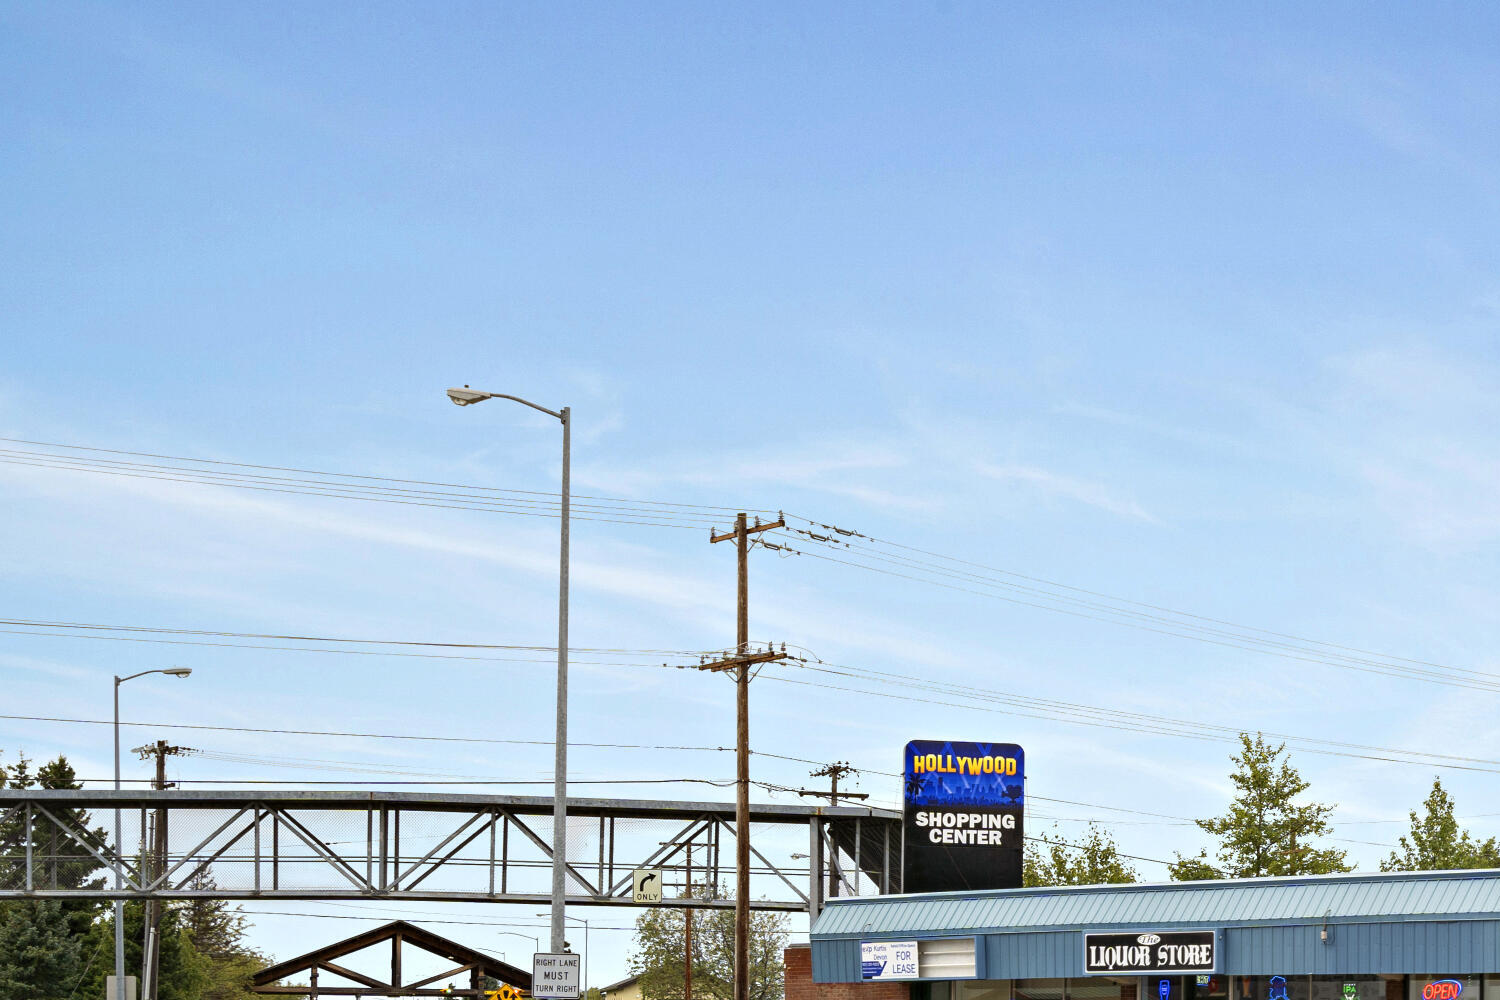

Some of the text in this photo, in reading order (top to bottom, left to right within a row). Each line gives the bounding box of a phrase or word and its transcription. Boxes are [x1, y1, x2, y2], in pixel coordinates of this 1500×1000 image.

[914, 754, 1017, 776] HOLLYWOOD
[915, 811, 1016, 829] SHOPPING
[929, 828, 1002, 845] CENTER
[637, 893, 659, 901] ONLY
[1139, 934, 1160, 944] The
[896, 951, 911, 961] FOR
[1089, 944, 1212, 970] LIQUOR STORE
[892, 964, 916, 974] LEASE
[544, 972, 568, 980] MUST
[1423, 983, 1459, 1000] OPEN
